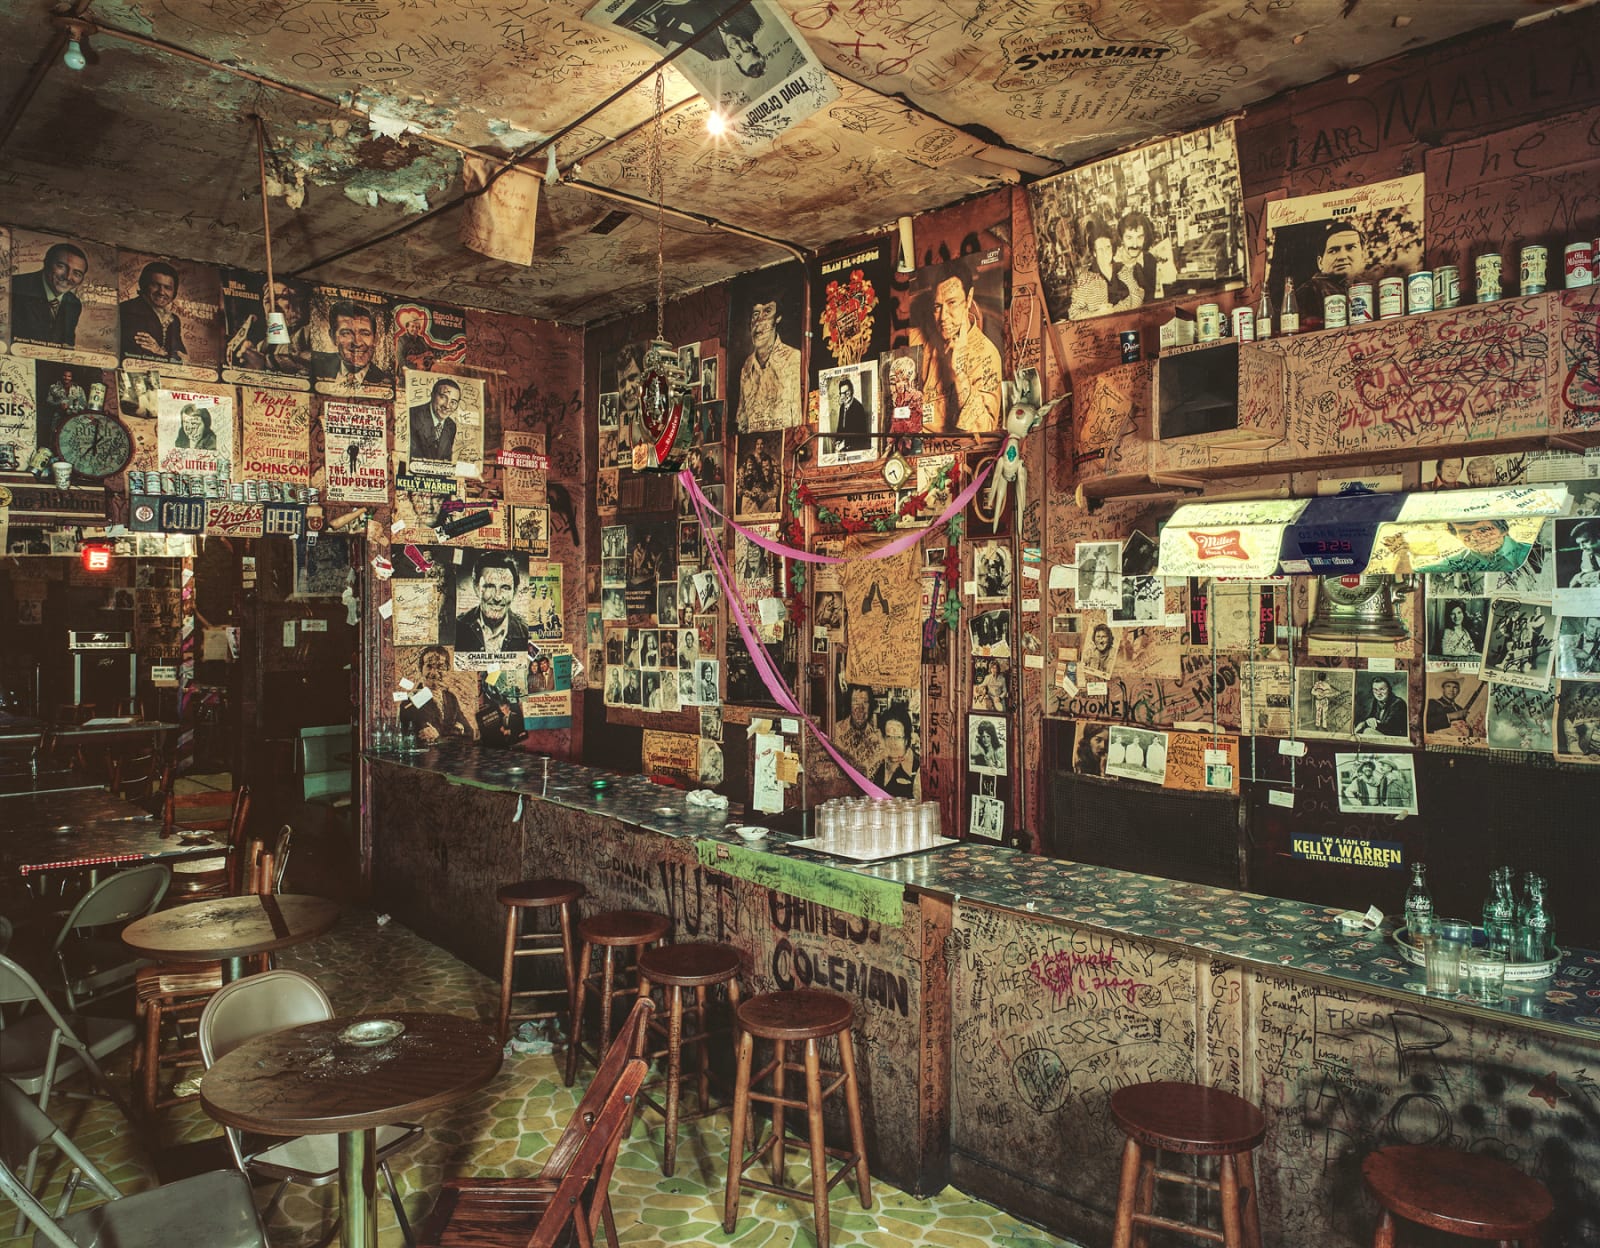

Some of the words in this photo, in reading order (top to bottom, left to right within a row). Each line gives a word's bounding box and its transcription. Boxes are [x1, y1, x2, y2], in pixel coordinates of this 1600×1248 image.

[1015, 46, 1171, 71] SWINEHART
[781, 76, 811, 106] Floyd
[747, 98, 785, 127] Cramer
[1332, 205, 1357, 217] RCA
[228, 280, 246, 290] Mac
[223, 287, 260, 301] Wiseman
[339, 289, 383, 305] WILLIAMS
[254, 391, 297, 407] Thanks
[266, 447, 287, 459] LITTLE
[502, 450, 531, 460] Welcome
[243, 461, 309, 477] JOHNSON
[515, 459, 539, 469] RECORDS
[359, 467, 385, 478] ELMER
[398, 478, 421, 488] KELLY
[423, 480, 457, 491] WARREN
[162, 501, 202, 530] COLD
[266, 508, 302, 534] BEER
[1195, 533, 1237, 550] Miller
[468, 652, 494, 660] CHARLIE
[1342, 838, 1358, 846] FAN
[1293, 839, 1333, 856] KELLY
[1339, 844, 1401, 864] WARREN
[1306, 853, 1327, 862] LITTLE
[1329, 855, 1353, 864] RICHIE
[1354, 858, 1390, 868] RECORDS
[998, 998, 1044, 1029] PARIS
[1325, 1008, 1387, 1031] FRED
